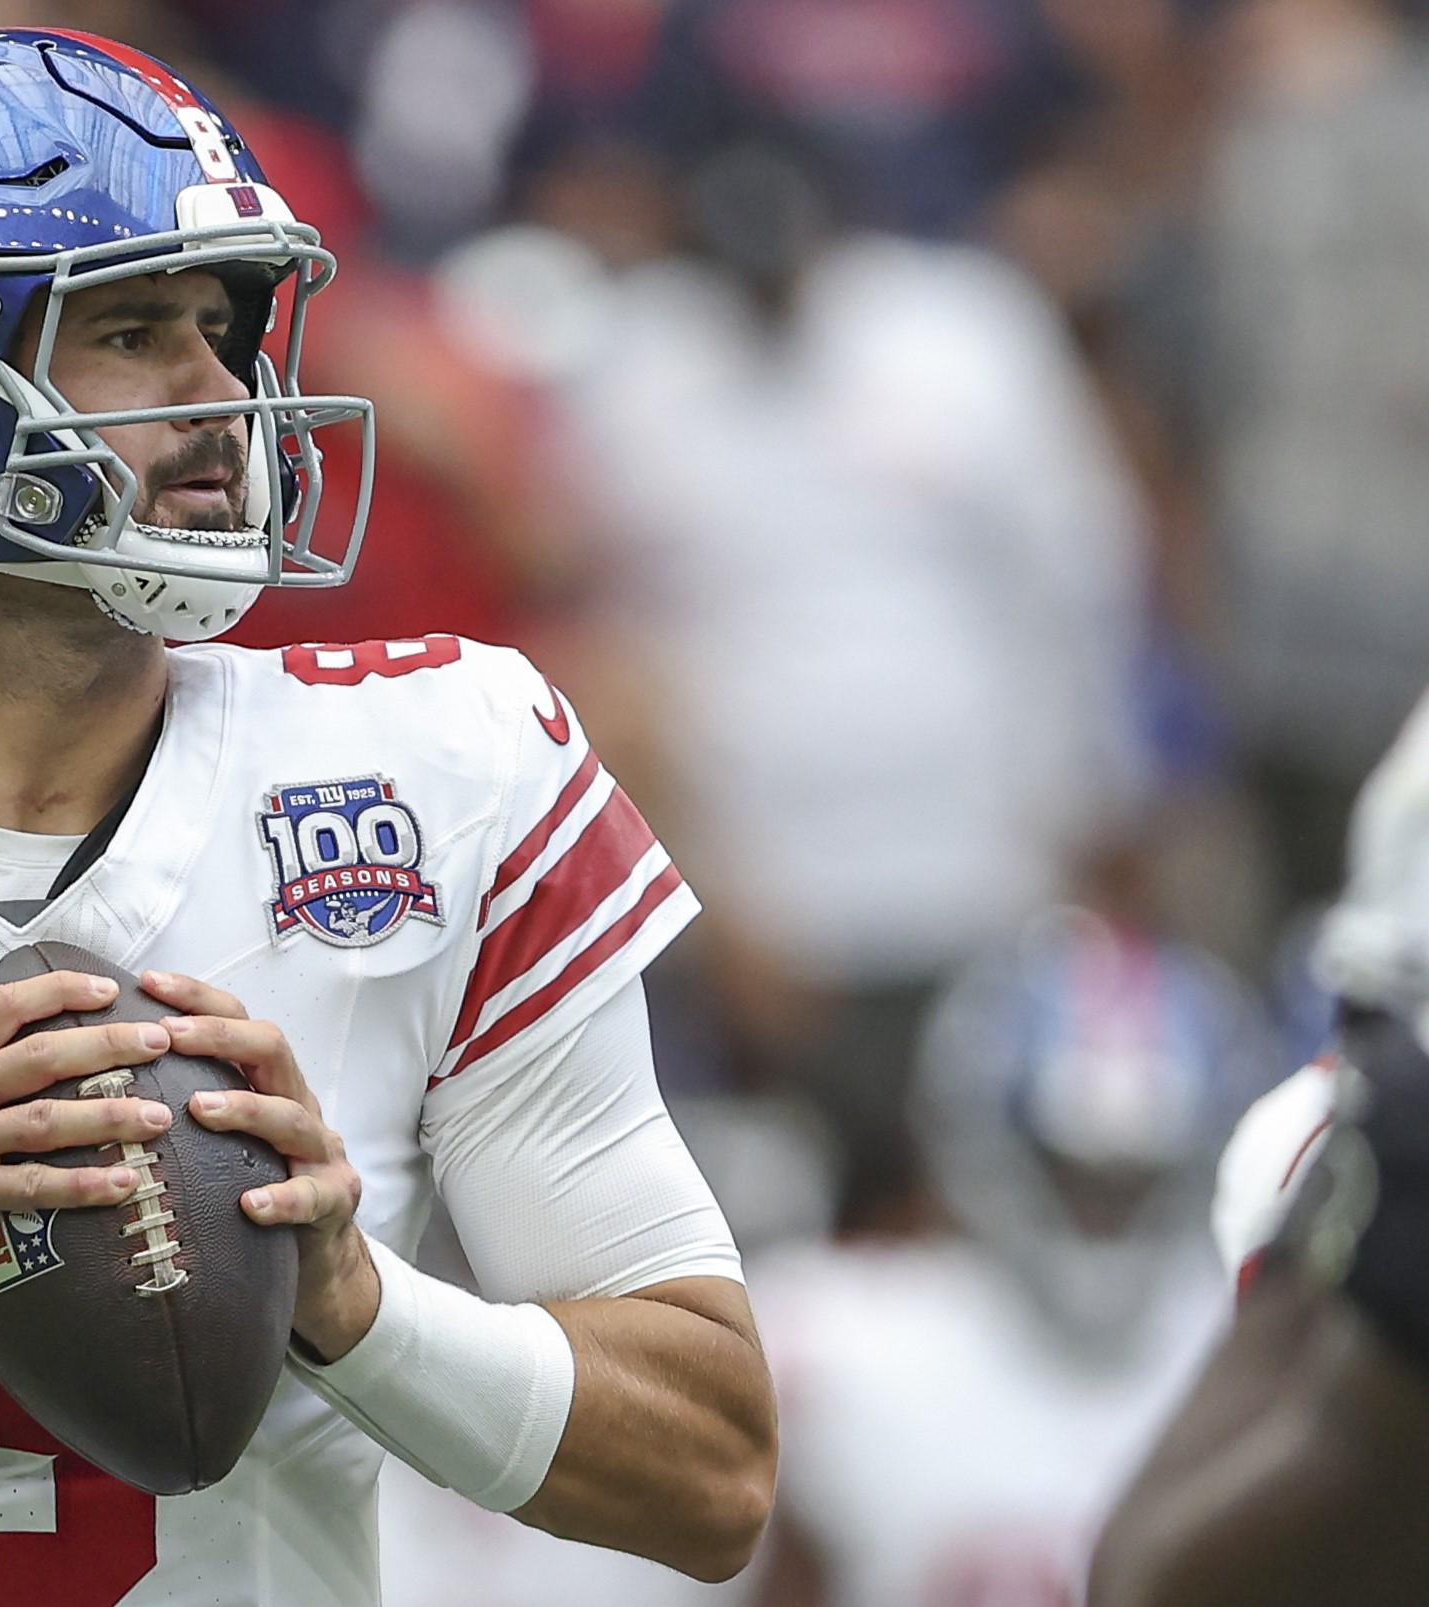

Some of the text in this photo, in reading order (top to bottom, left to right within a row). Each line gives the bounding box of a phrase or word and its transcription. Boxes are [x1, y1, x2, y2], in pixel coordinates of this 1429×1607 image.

[177, 106, 237, 181] 8
[281, 636, 462, 686] 8
[289, 793, 316, 806] EST.
[346, 786, 376, 801] 1925
[264, 803, 420, 884] 100
[290, 869, 412, 902] SEASONS
